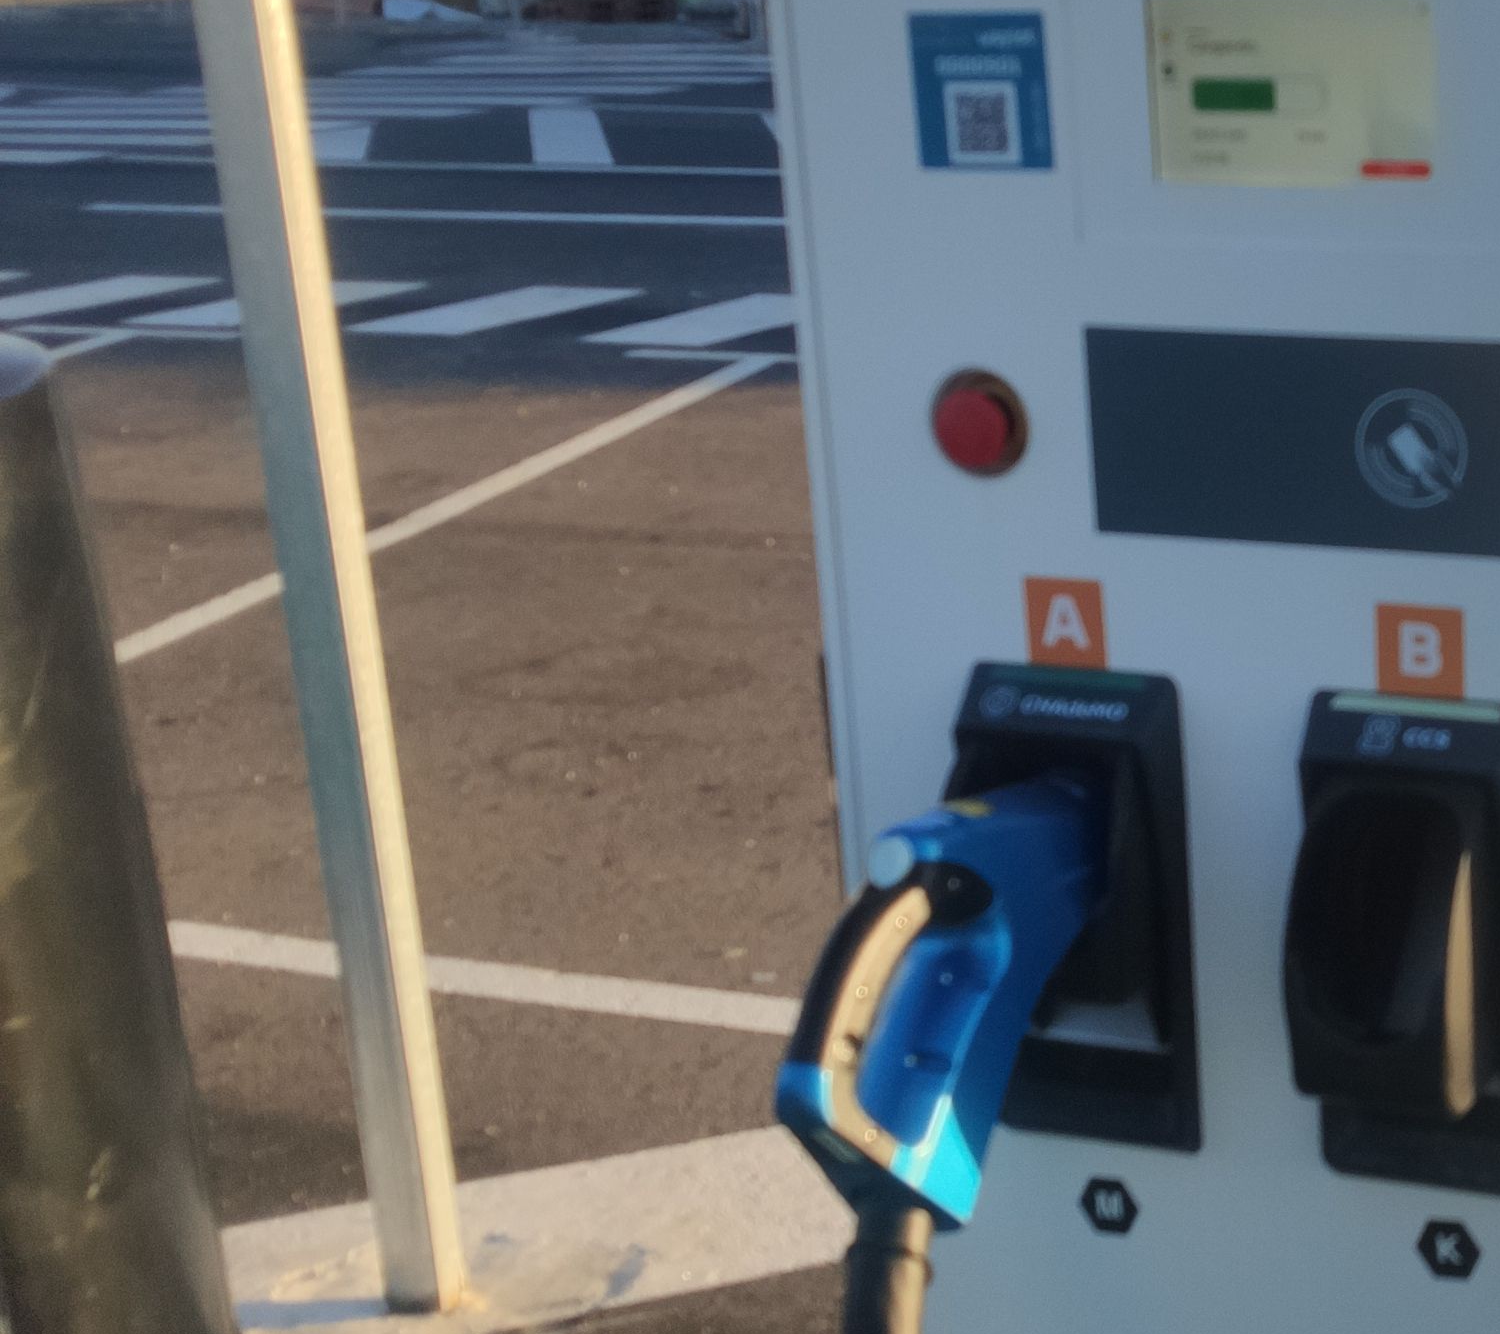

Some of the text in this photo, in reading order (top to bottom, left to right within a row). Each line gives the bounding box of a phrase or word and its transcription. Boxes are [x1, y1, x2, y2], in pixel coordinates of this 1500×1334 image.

[1041, 593, 1092, 650] A
[1398, 620, 1443, 679] B
[1435, 1230, 1463, 1267] K
